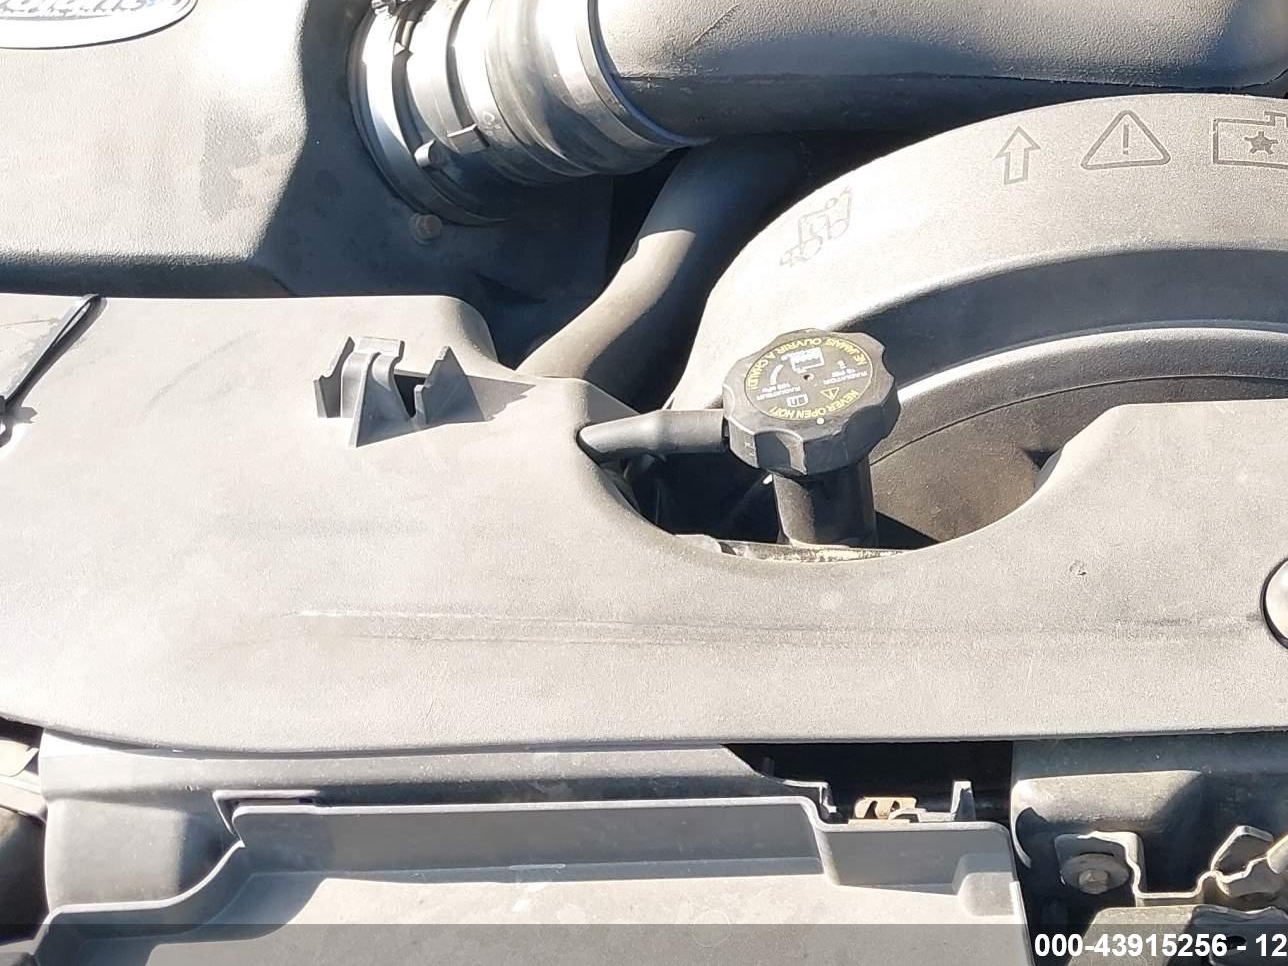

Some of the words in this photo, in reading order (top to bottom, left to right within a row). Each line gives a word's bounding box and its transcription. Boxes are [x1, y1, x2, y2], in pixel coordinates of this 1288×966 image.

[774, 337, 822, 354] OUVRIR
[825, 338, 860, 355] JAMAIS
[852, 353, 868, 366] NE
[747, 359, 768, 391] CHAUD!
[826, 389, 859, 412] NEVER
[768, 405, 795, 419] HOT!
[796, 407, 827, 418] OPEN
